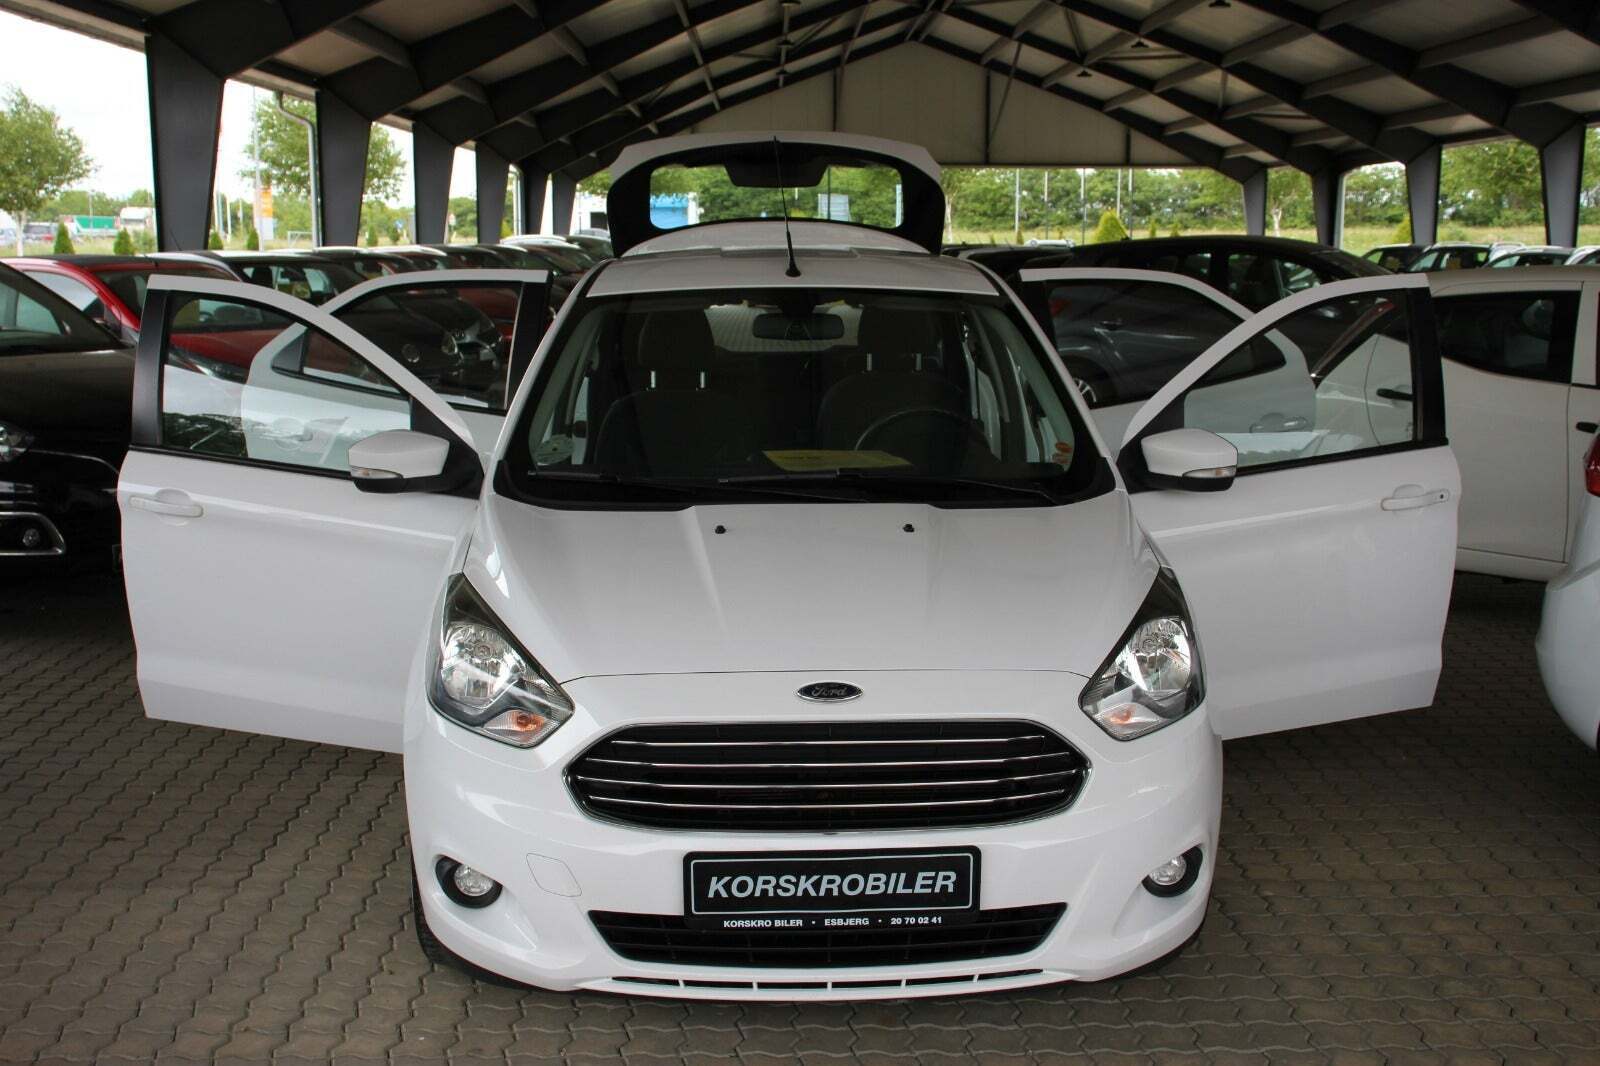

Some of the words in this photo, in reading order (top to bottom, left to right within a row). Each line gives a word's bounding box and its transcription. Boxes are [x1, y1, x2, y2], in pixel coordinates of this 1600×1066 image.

[811, 685, 848, 697] Ford
[707, 871, 957, 899] KORSKROBILER
[723, 919, 773, 928] KORSKRO
[774, 919, 803, 928] BILER
[824, 918, 870, 927] ESBJERG
[890, 917, 902, 925] 20
[904, 917, 916, 925] 70
[917, 916, 930, 924] 02
[931, 916, 943, 924] 41
